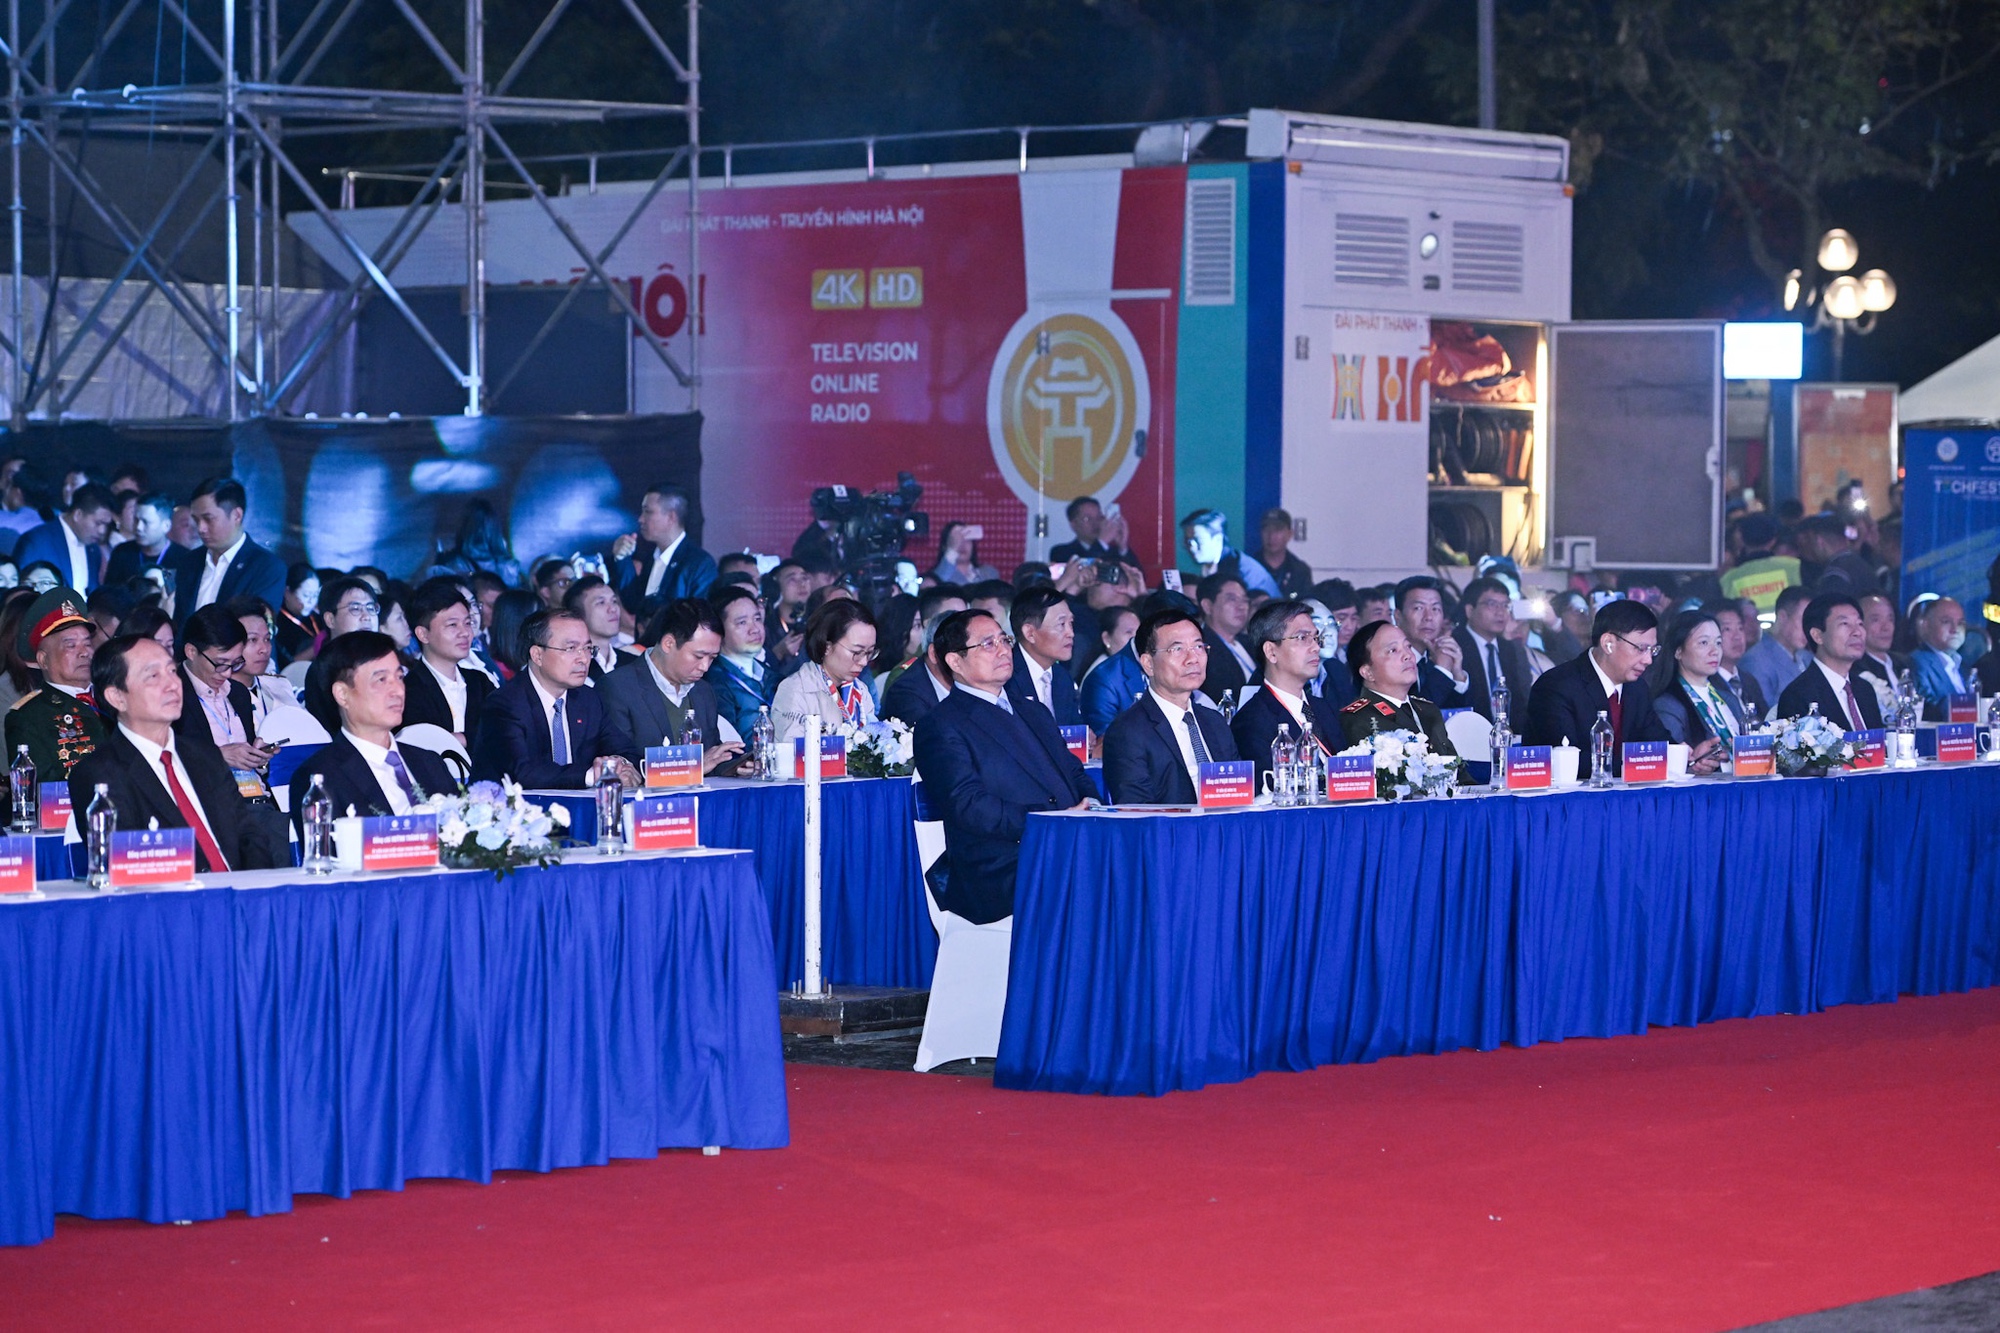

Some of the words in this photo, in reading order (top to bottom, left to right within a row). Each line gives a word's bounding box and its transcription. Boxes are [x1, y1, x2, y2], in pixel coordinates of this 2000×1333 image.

[724, 214, 770, 231] THANH
[836, 206, 872, 227] HÌNH
[873, 205, 895, 225] HÀ
[897, 203, 925, 228] NỘI
[816, 272, 859, 305] 4K
[876, 272, 919, 303] HD
[1383, 315, 1418, 332] THANH
[810, 341, 919, 363] TELEVISION
[810, 373, 880, 394] ONLINE
[810, 402, 871, 423] RADIO
[1739, 579, 1785, 598] SECURITY
